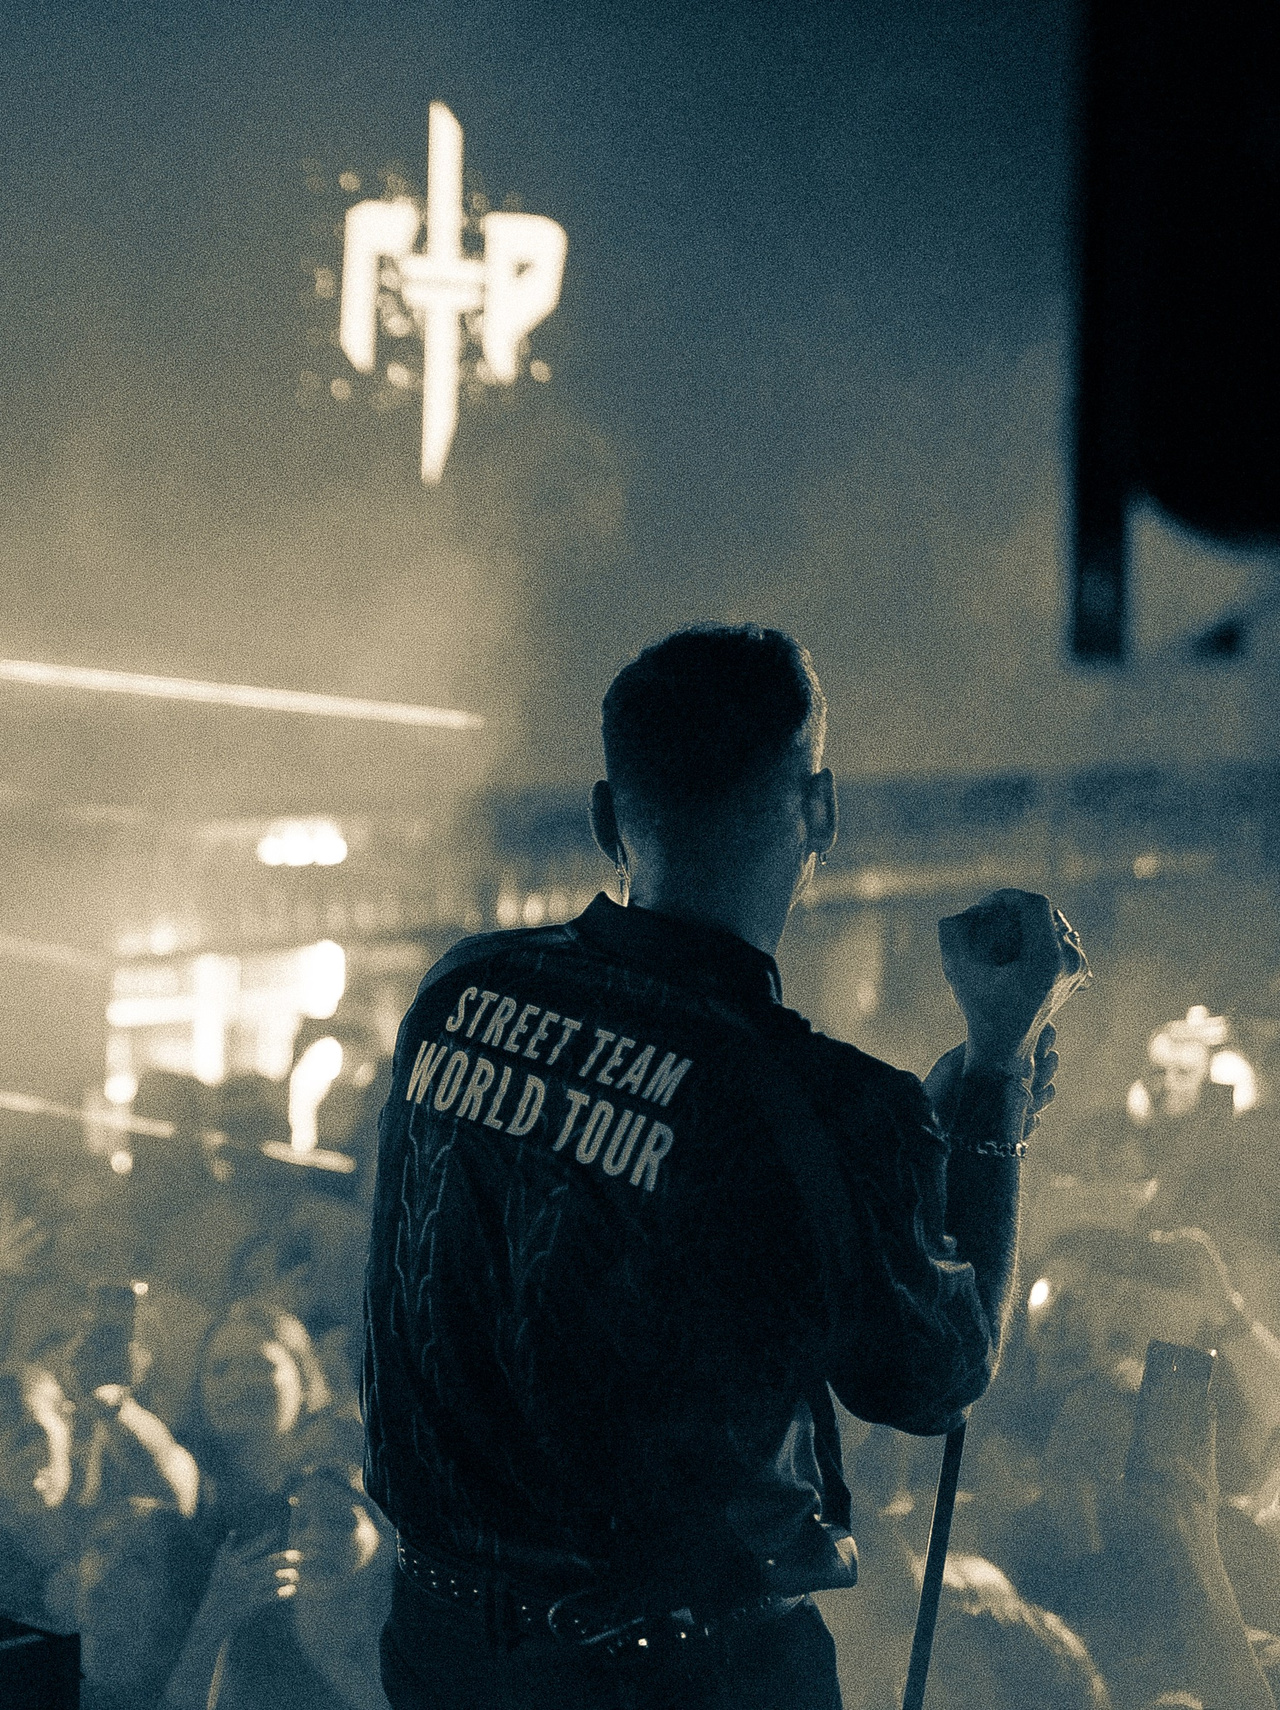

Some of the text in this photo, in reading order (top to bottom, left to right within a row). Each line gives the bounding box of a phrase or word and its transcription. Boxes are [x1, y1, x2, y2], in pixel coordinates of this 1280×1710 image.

[445, 986, 694, 1106] STREET TEAM
[405, 1040, 675, 1193] WORLD TOUR
